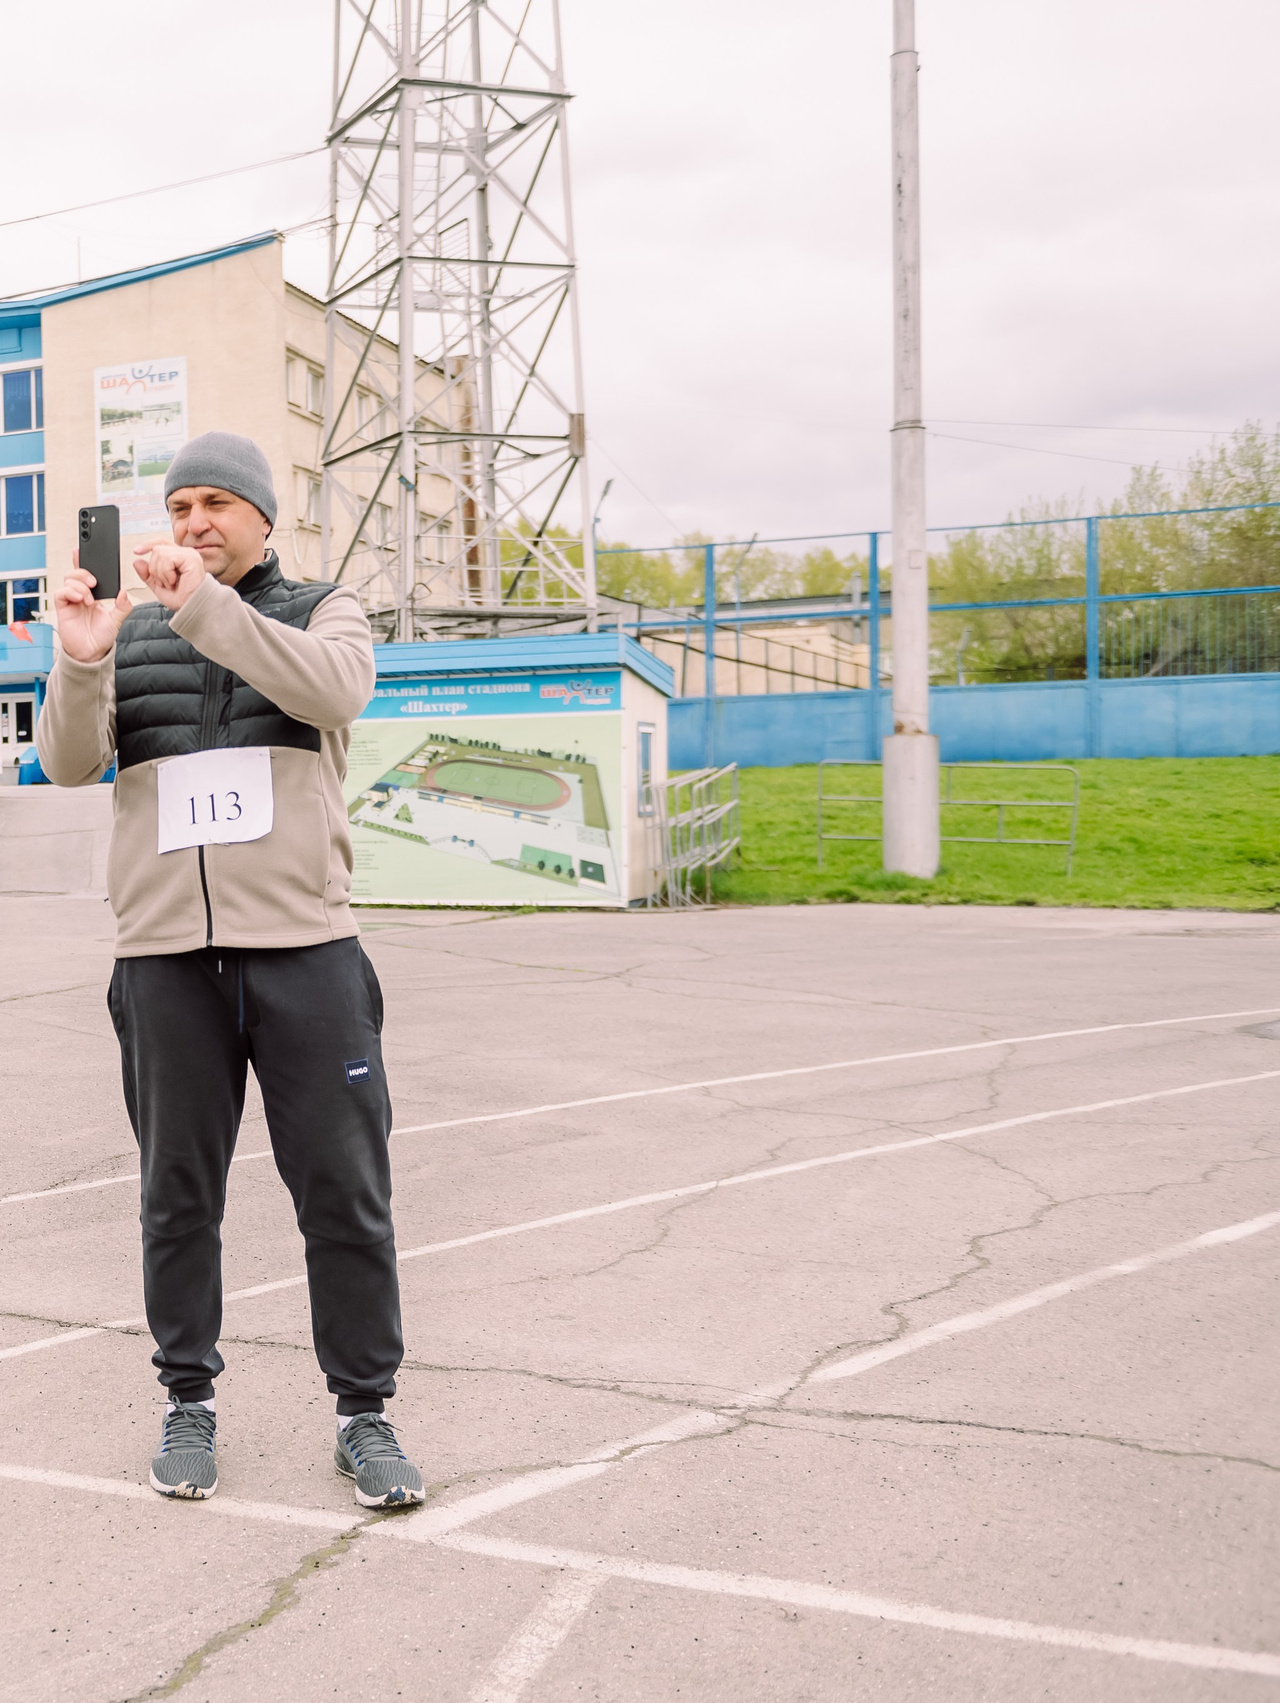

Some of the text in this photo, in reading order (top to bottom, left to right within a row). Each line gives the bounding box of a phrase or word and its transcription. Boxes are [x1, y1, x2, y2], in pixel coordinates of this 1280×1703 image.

[431, 685, 465, 696] план
[467, 683, 531, 695] стадиона
[400, 701, 468, 715] «Шахтер»
[188, 791, 243, 826] 113
[349, 1066, 368, 1077] HUGO
